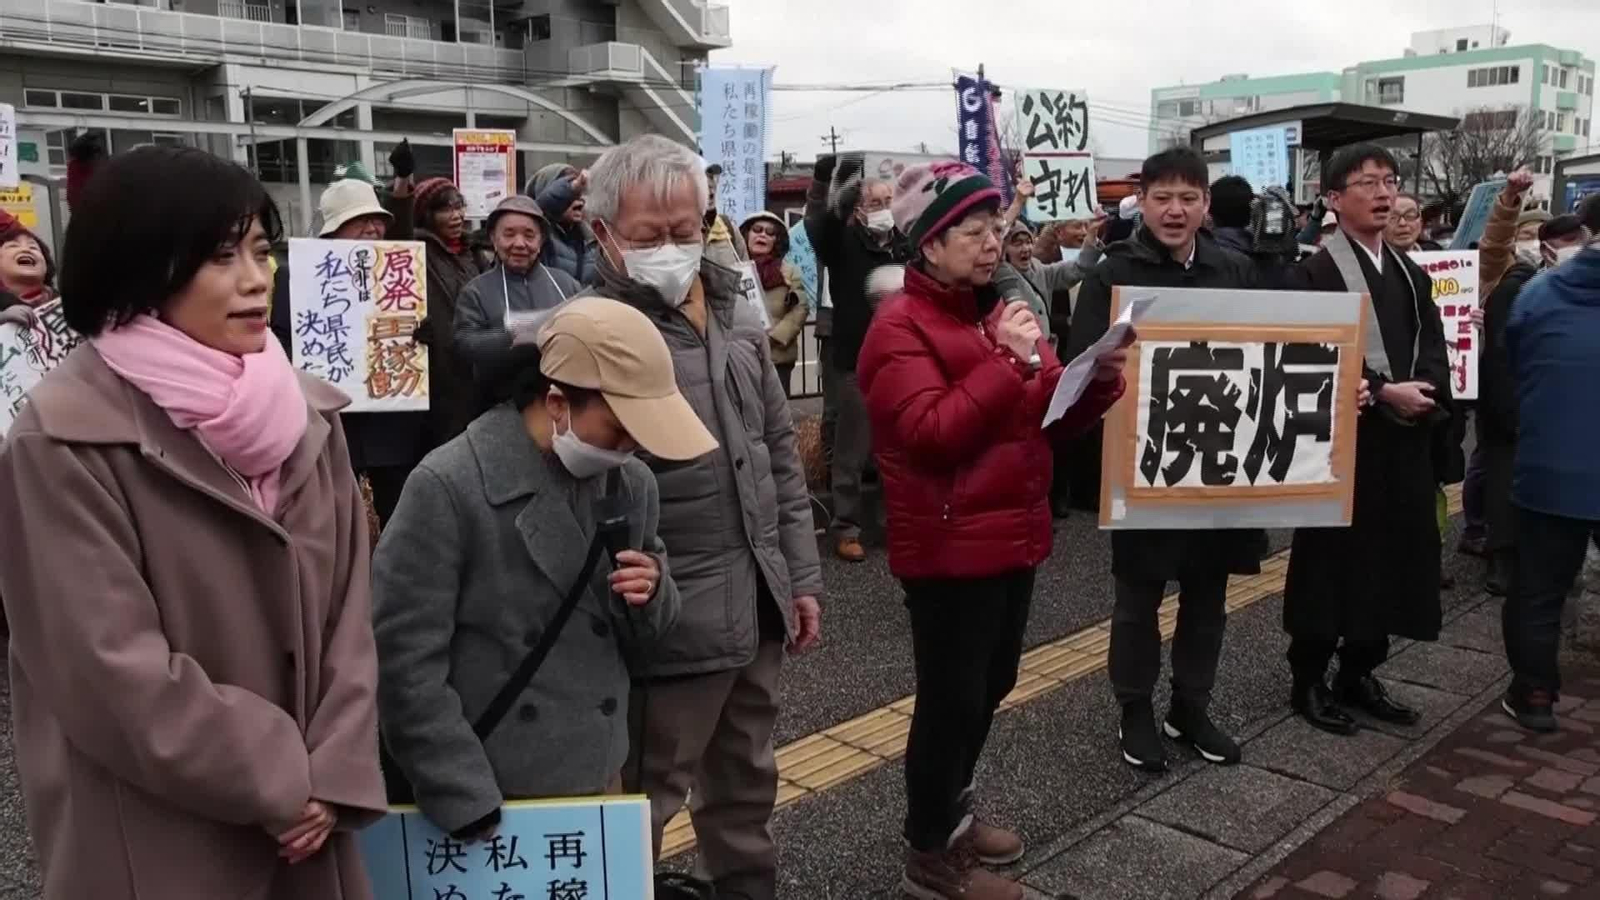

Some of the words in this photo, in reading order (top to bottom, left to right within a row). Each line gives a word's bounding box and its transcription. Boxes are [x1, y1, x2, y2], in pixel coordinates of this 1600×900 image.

[1022, 91, 1089, 151] 公約
[1029, 159, 1094, 219] 守れ
[315, 250, 355, 384] 私たち県民が
[1139, 340, 1340, 487] 廃炉
